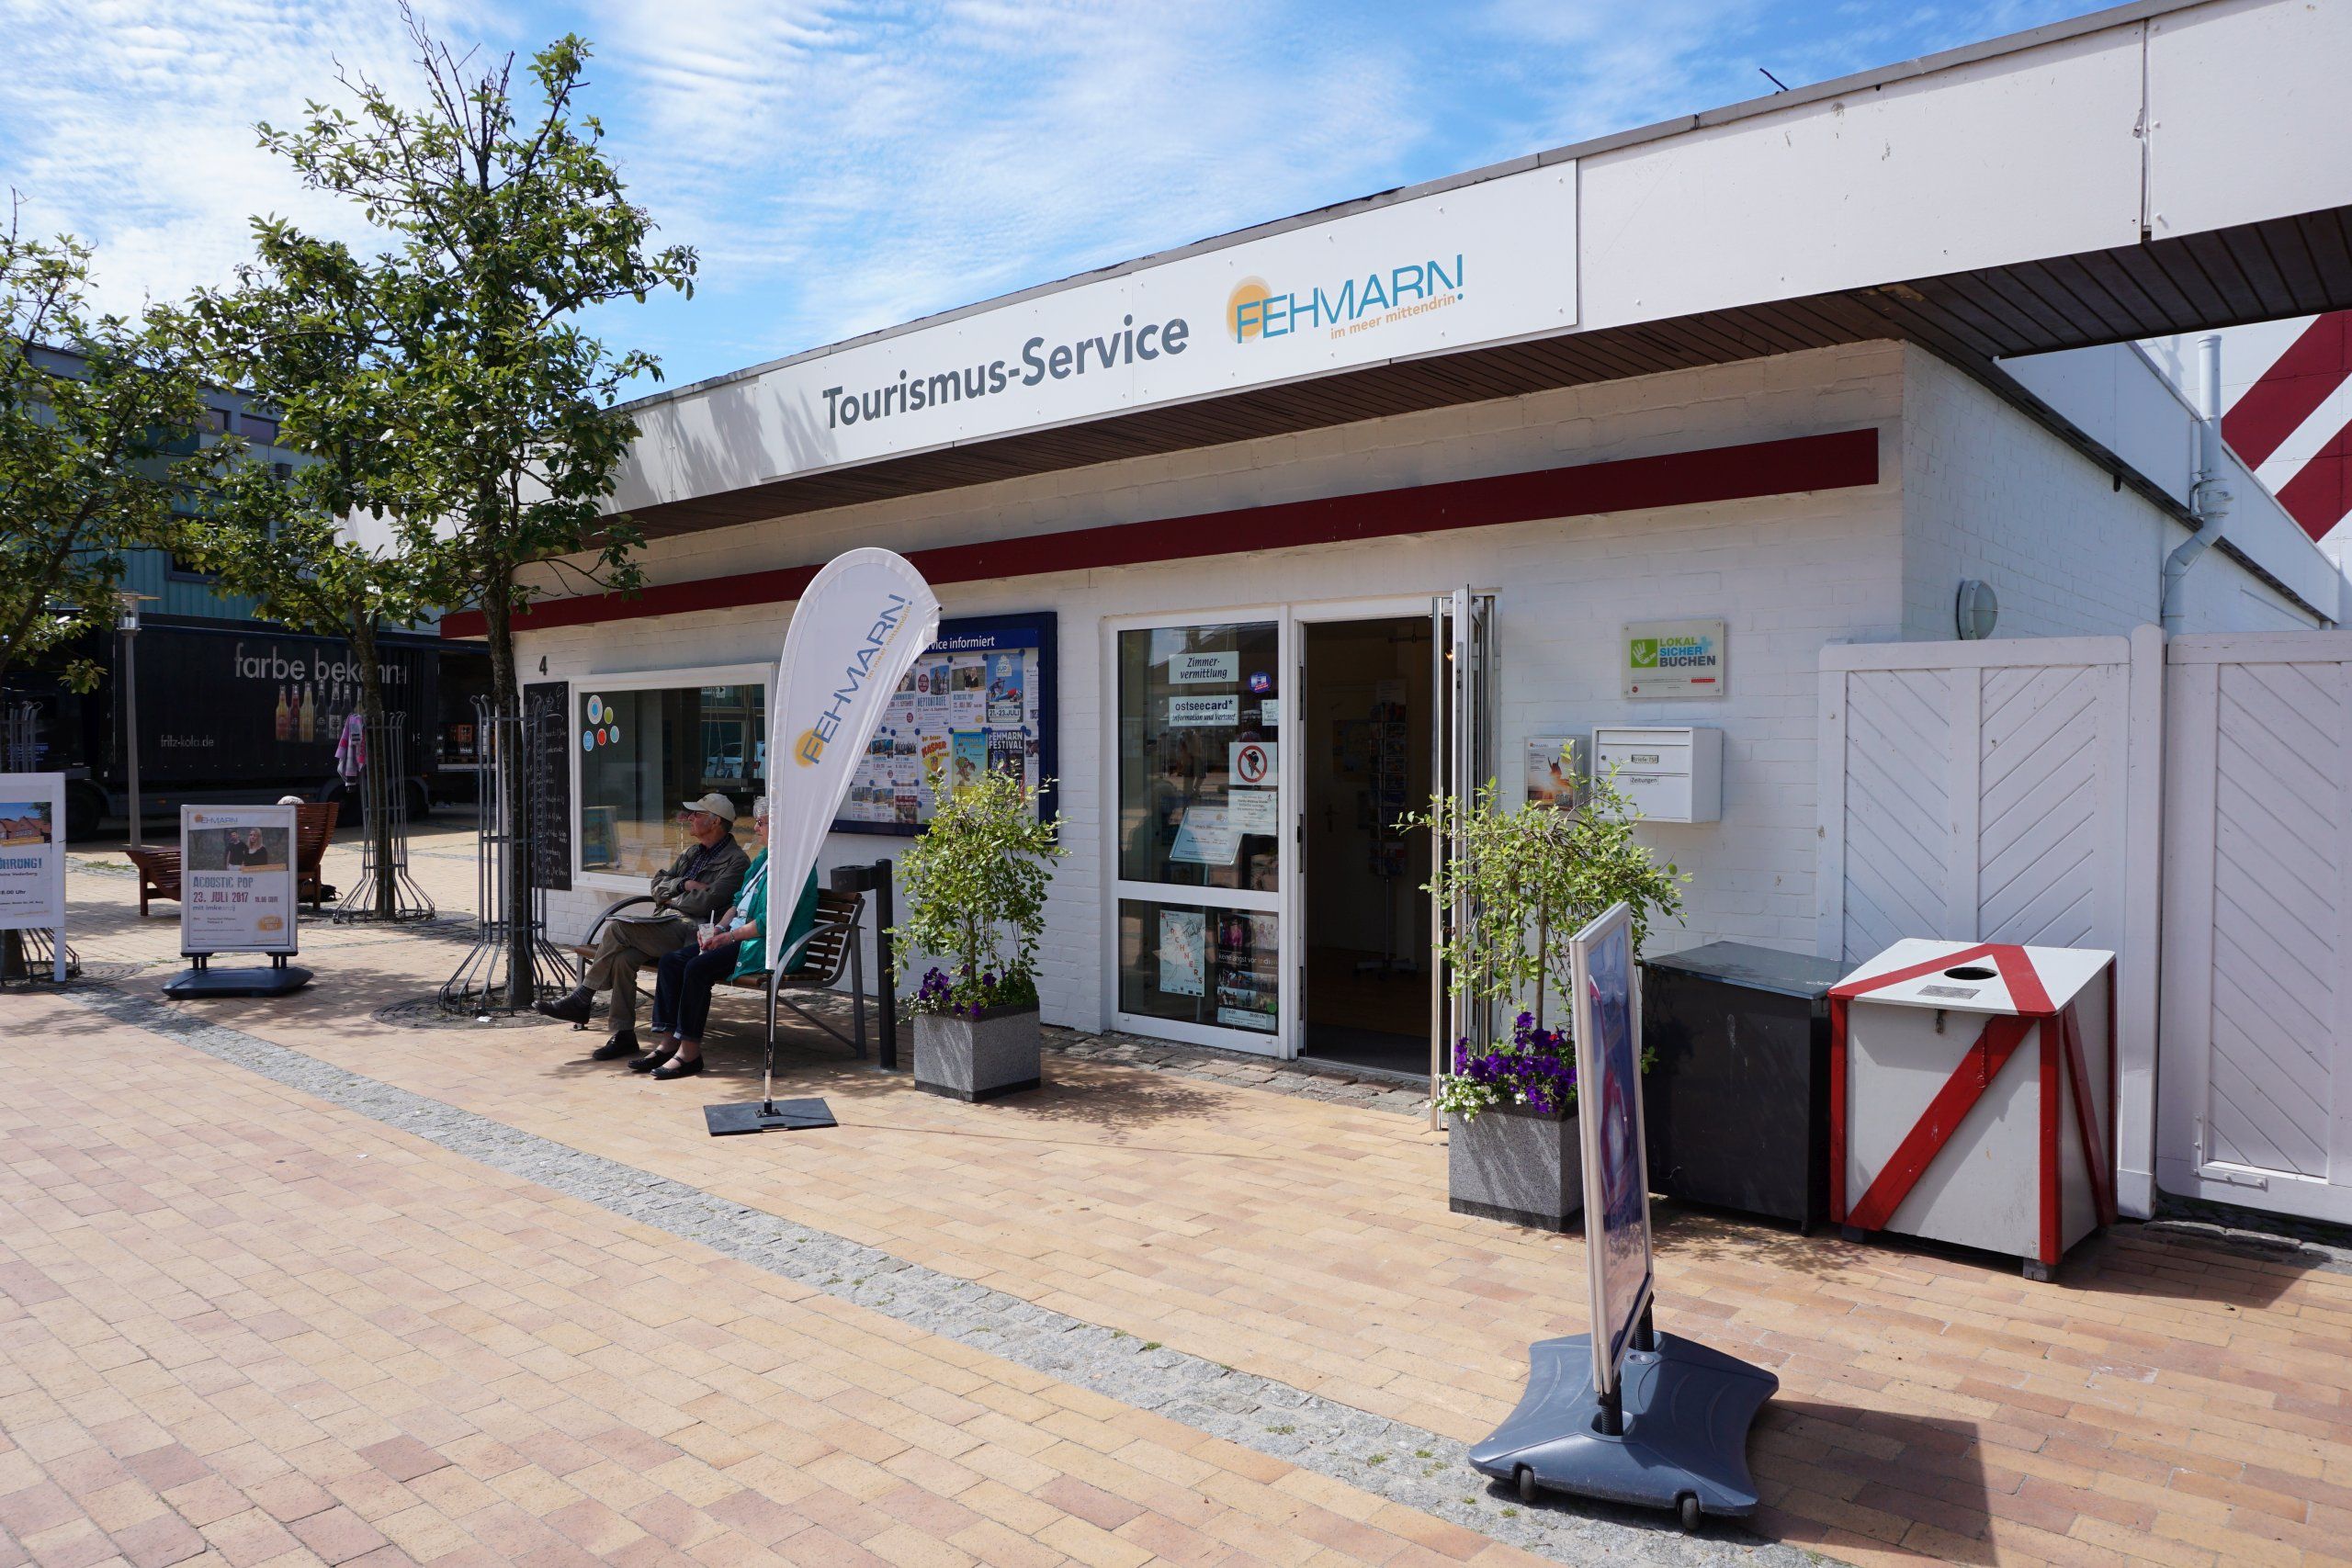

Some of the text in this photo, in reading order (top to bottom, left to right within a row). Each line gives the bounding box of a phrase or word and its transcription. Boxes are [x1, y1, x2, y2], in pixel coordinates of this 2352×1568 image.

[1237, 254, 1464, 344] FEHMARN!
[1330, 294, 1456, 340] im meer mittendrin
[822, 313, 1190, 430] Tourismus-Service
[949, 635, 995, 649] informiert
[1659, 637, 1698, 647] LOKAL
[1659, 646, 1702, 657] SICHER
[233, 642, 306, 681] farbe
[539, 656, 548, 676] 4
[1187, 657, 1221, 668] Zimmer-
[1659, 655, 1716, 668] BUCHEN
[801, 593, 913, 764] FEHMARN!
[1180, 669, 1228, 680] vermittlung
[989, 731, 1023, 740] FEHMARN
[989, 740, 1023, 750] FESTIVAL
[193, 876, 254, 888] ACOUSTIC POP
[193, 891, 208, 903] 23.
[210, 891, 229, 903] JULI
[232, 892, 249, 903] 2017
[1232, 953, 1248, 965] angst
